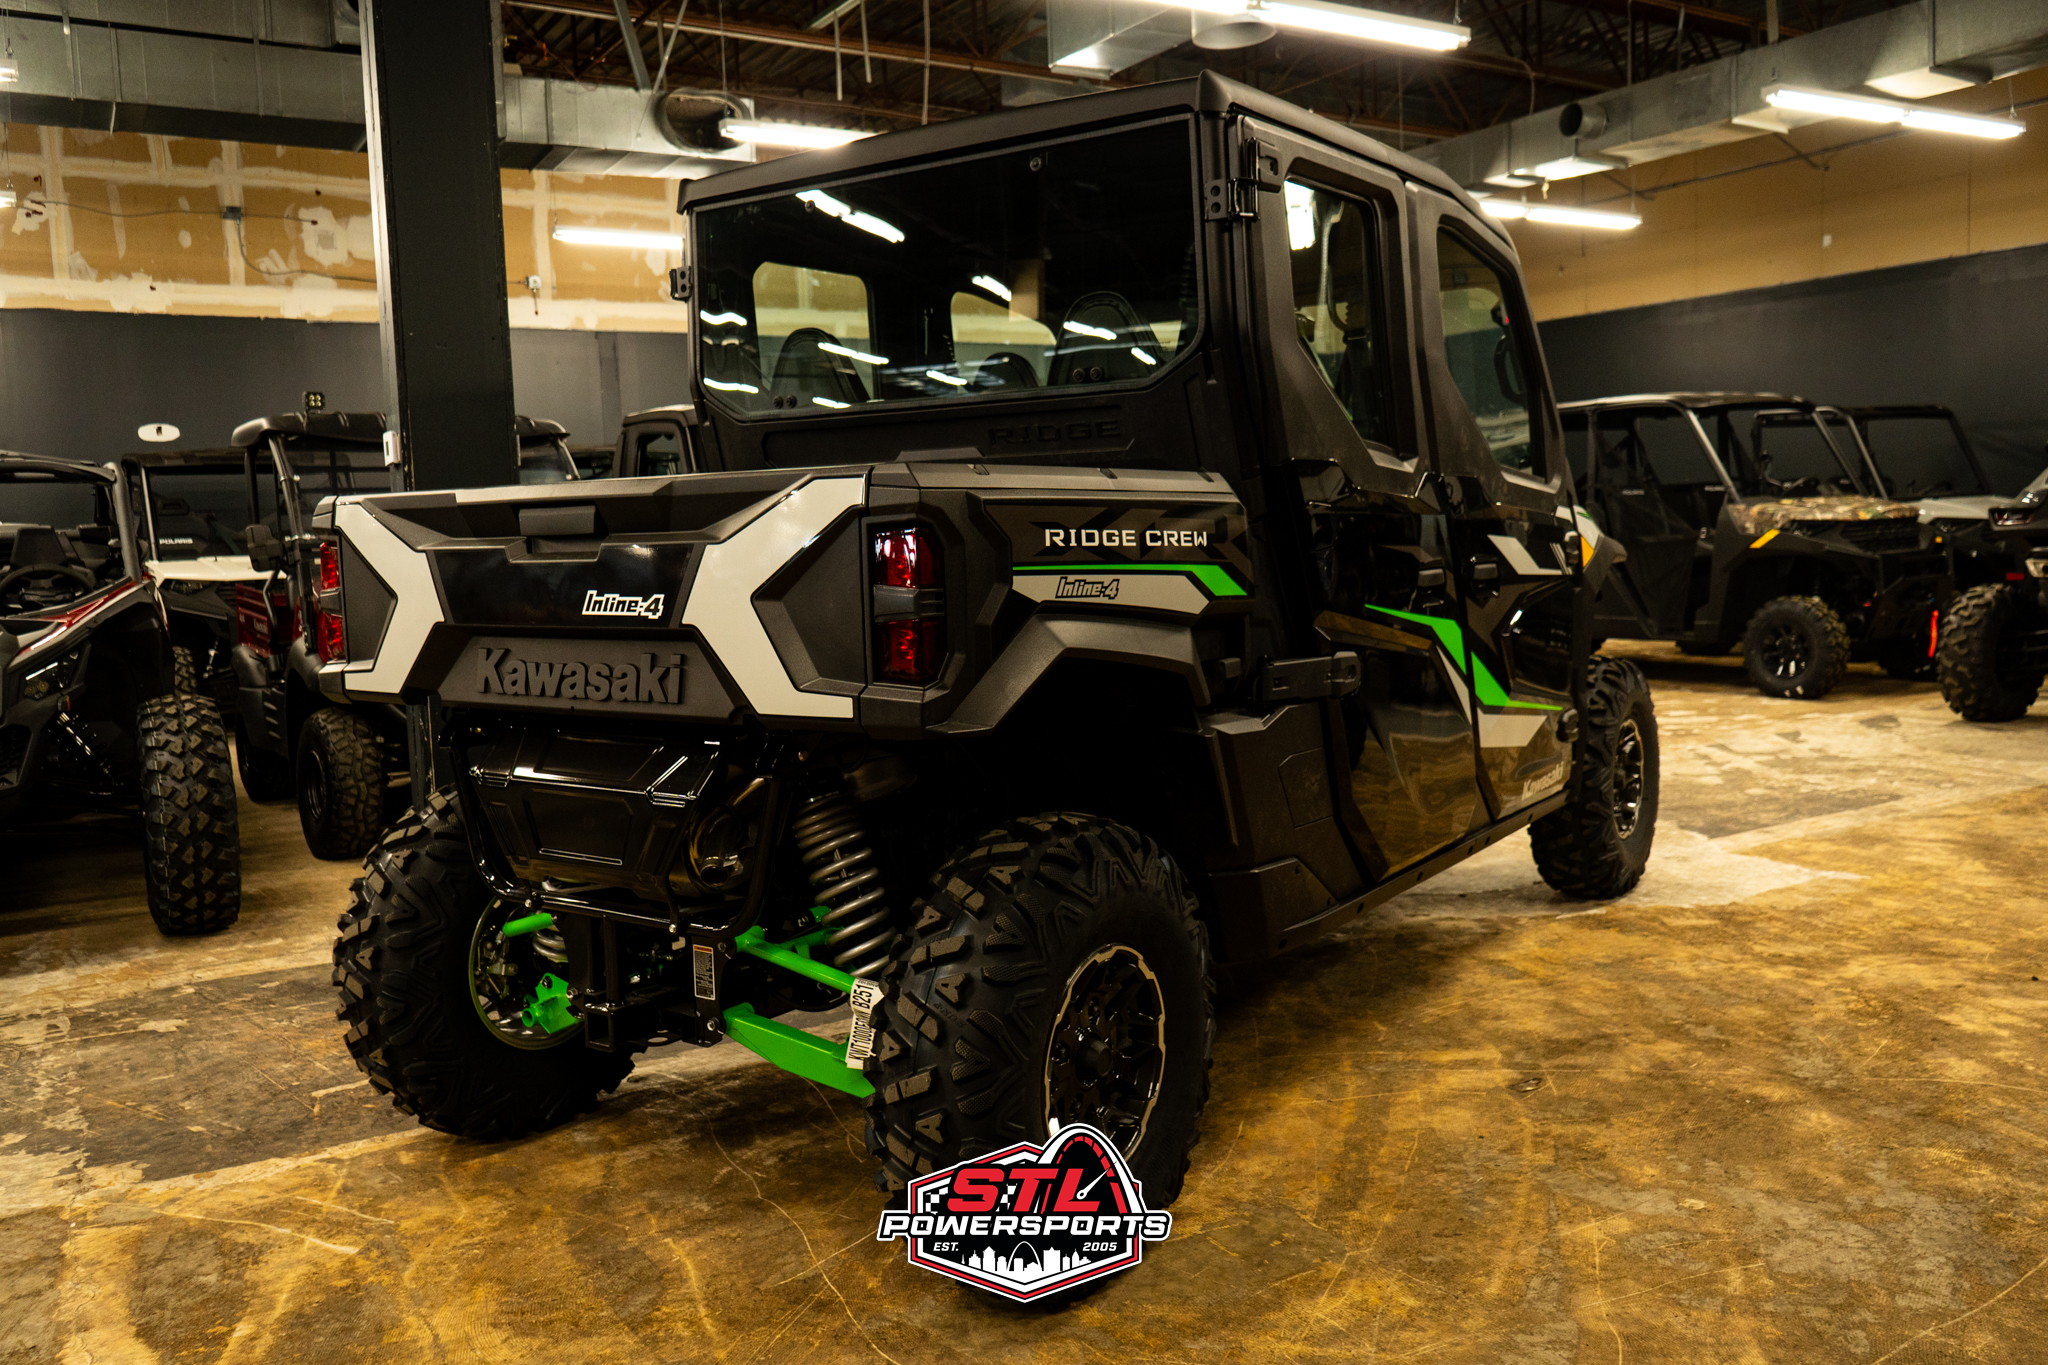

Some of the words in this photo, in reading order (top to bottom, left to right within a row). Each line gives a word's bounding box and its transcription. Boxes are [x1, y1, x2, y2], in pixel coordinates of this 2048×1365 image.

[986, 419, 1121, 446] RIDGE
[1044, 528, 1137, 547] RIDGE
[1145, 530, 1208, 547] CREW
[477, 647, 686, 704] Kawasaki
[852, 983, 875, 1010] B251
